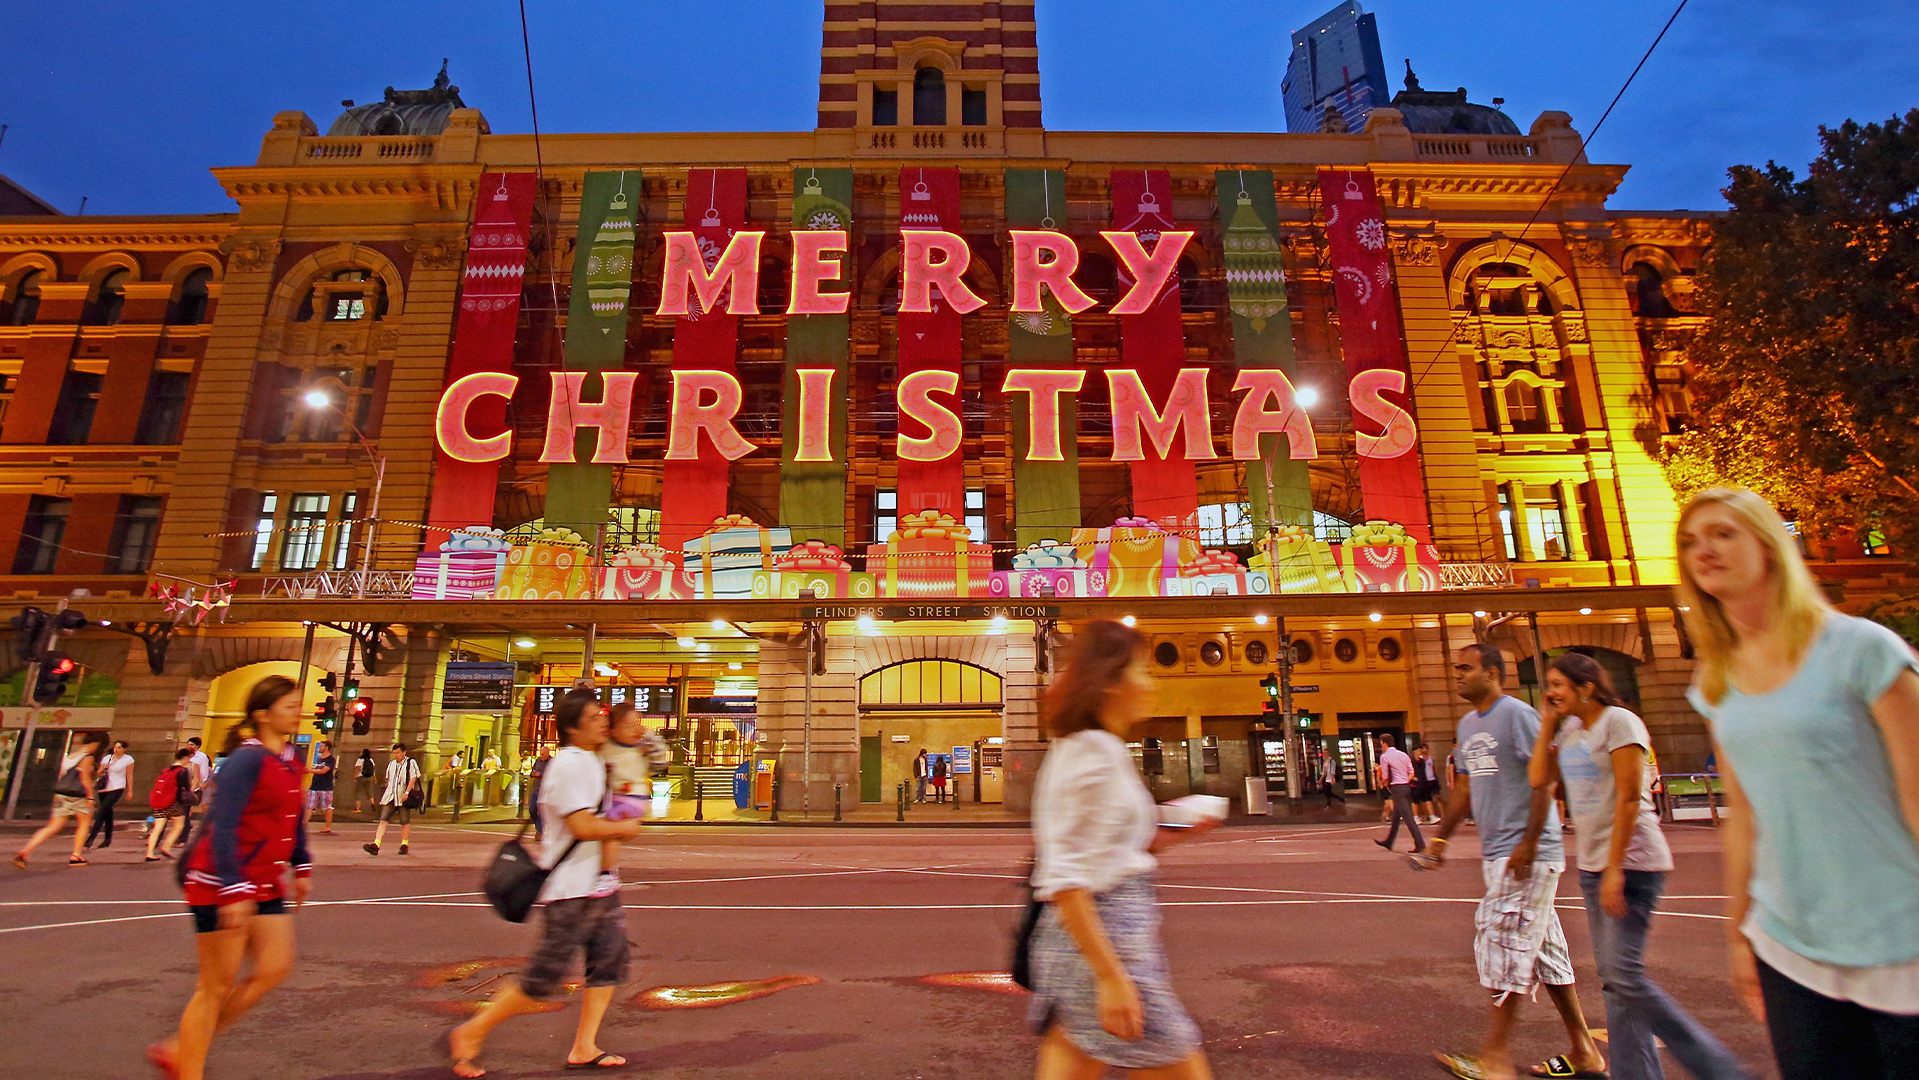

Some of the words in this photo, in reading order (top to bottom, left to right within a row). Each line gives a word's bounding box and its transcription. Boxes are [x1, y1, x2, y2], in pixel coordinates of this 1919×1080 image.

[655, 229, 1195, 315] MERRY
[435, 367, 1418, 464] CHRISTMAS
[815, 606, 884, 618] FLINDERS
[908, 606, 961, 617] STREET
[983, 606, 1047, 617] STATION
[736, 772, 748, 781] mx
